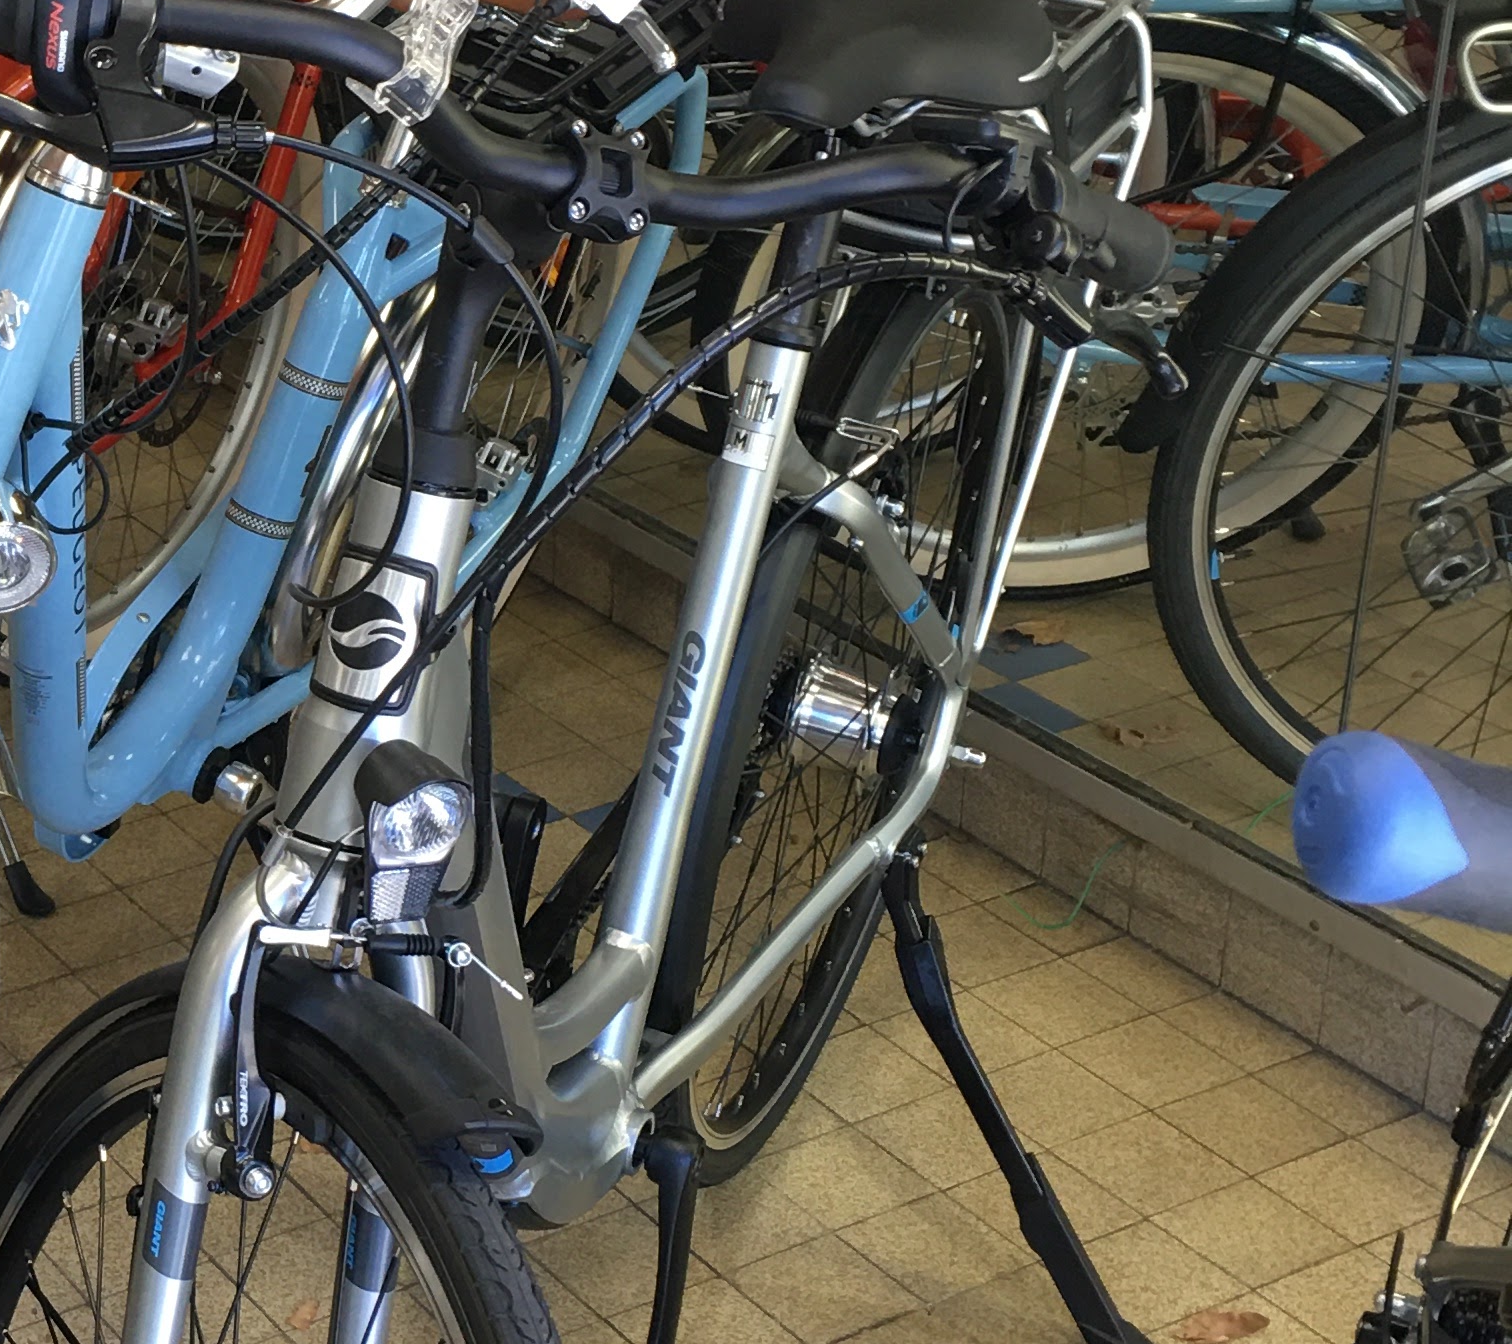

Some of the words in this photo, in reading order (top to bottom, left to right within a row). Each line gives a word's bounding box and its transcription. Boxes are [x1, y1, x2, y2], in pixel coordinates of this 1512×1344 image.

[734, 431, 749, 449] M
[652, 630, 706, 798] GIANT
[239, 1070, 249, 1127] TEKTRO
[150, 1200, 167, 1258] GIANT
